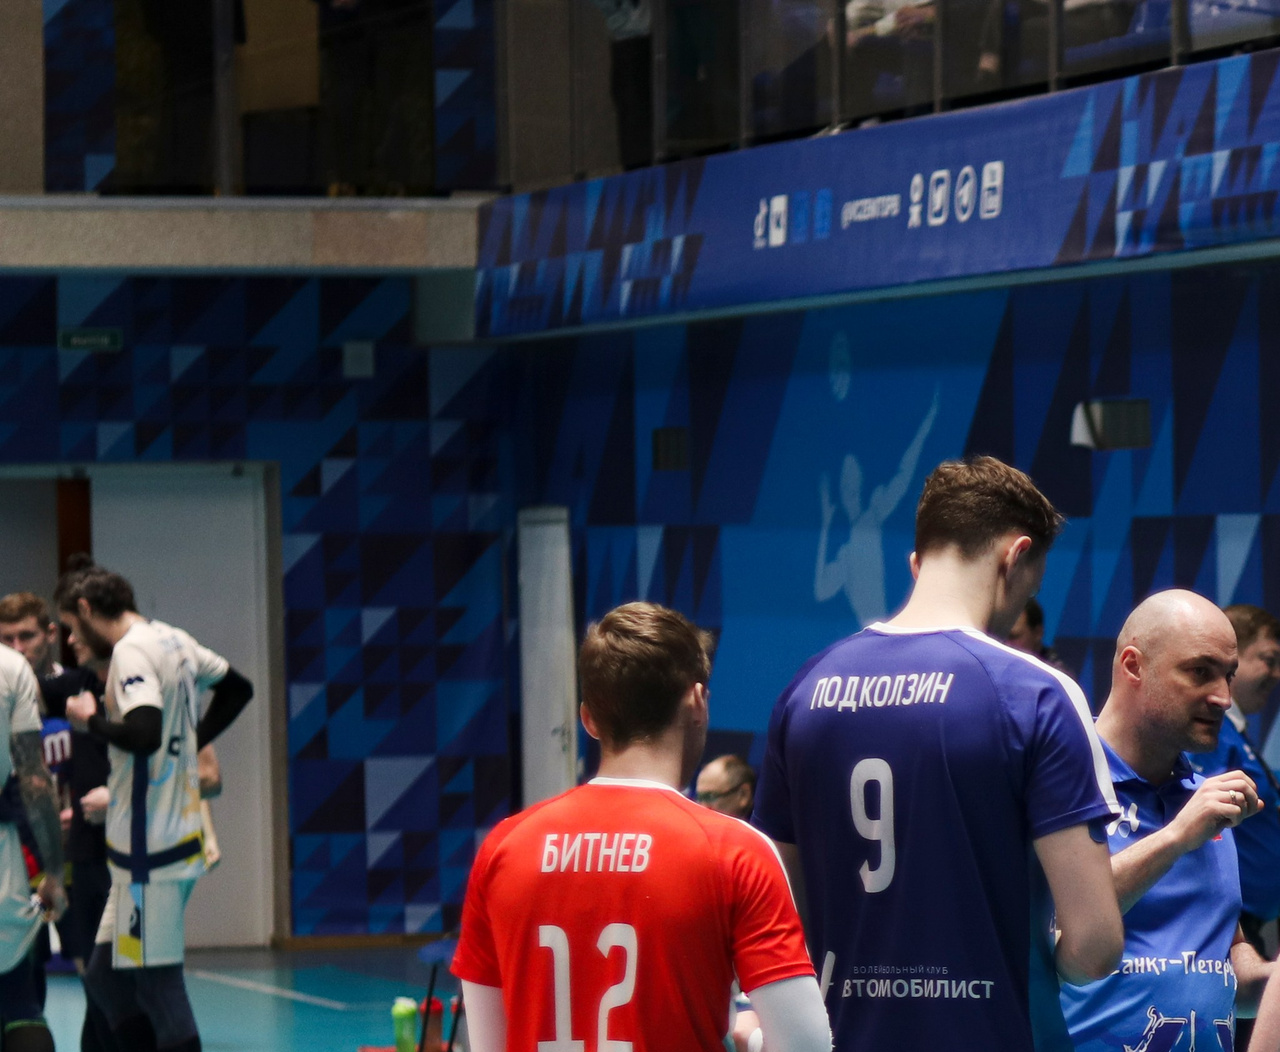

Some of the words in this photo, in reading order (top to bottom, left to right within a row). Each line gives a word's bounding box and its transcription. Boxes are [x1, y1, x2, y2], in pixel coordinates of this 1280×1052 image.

[810, 671, 954, 712] ПОДКОЛЗИН
[849, 757, 896, 894] 9
[540, 832, 654, 874] БИТНЕВ
[841, 978, 995, 999] ВТОМОБИЛИСТ
[926, 966, 949, 975] КЛУБ
